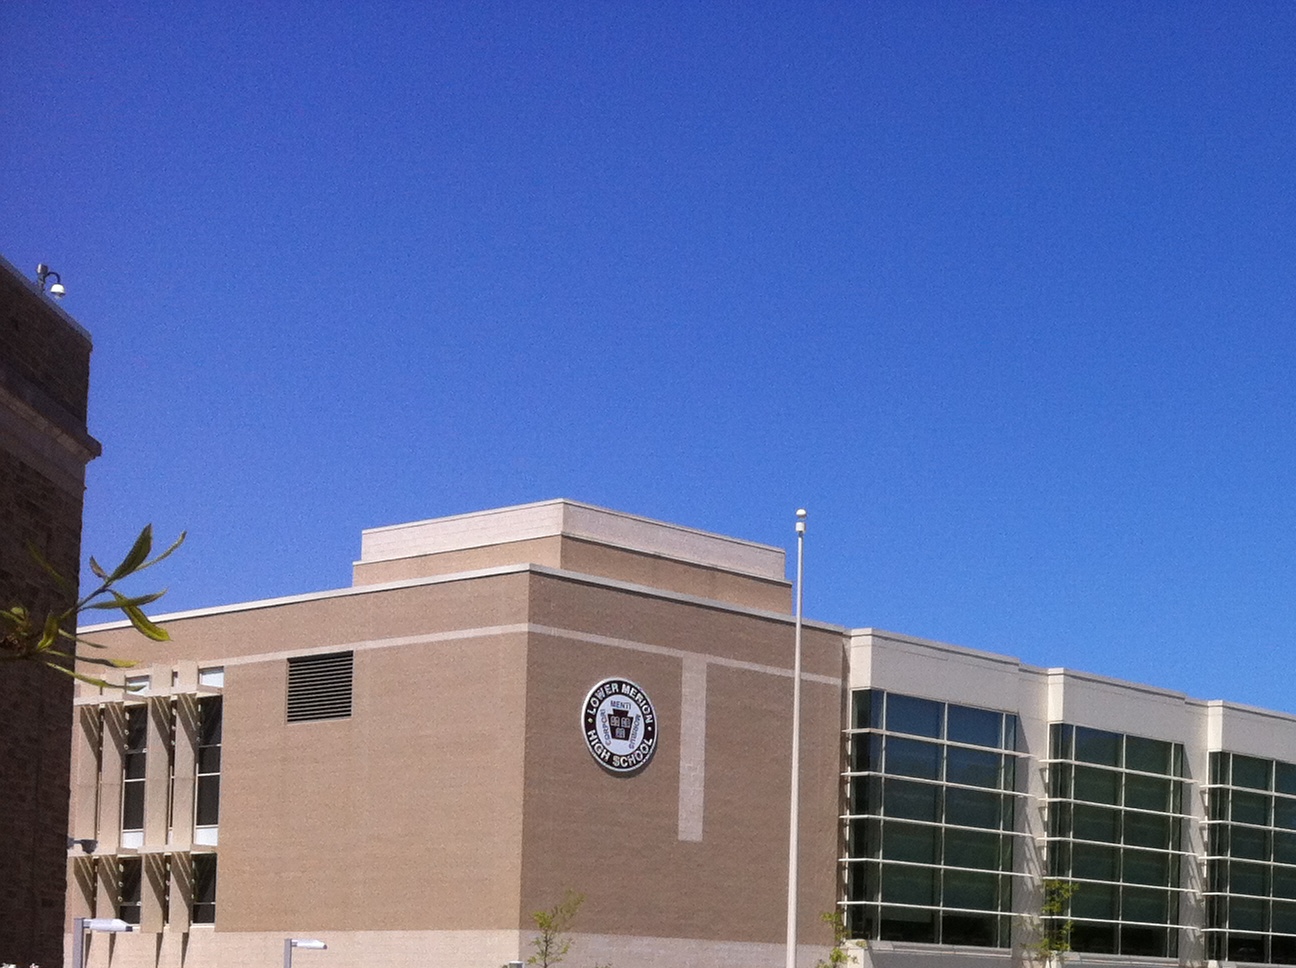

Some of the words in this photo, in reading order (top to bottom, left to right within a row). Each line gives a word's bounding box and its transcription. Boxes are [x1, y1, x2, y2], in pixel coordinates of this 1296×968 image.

[587, 682, 619, 716] LOWER
[621, 683, 654, 725] MERION
[610, 699, 632, 710] MENTI
[587, 729, 611, 763] HIGH
[612, 738, 653, 768] SCHOOL
